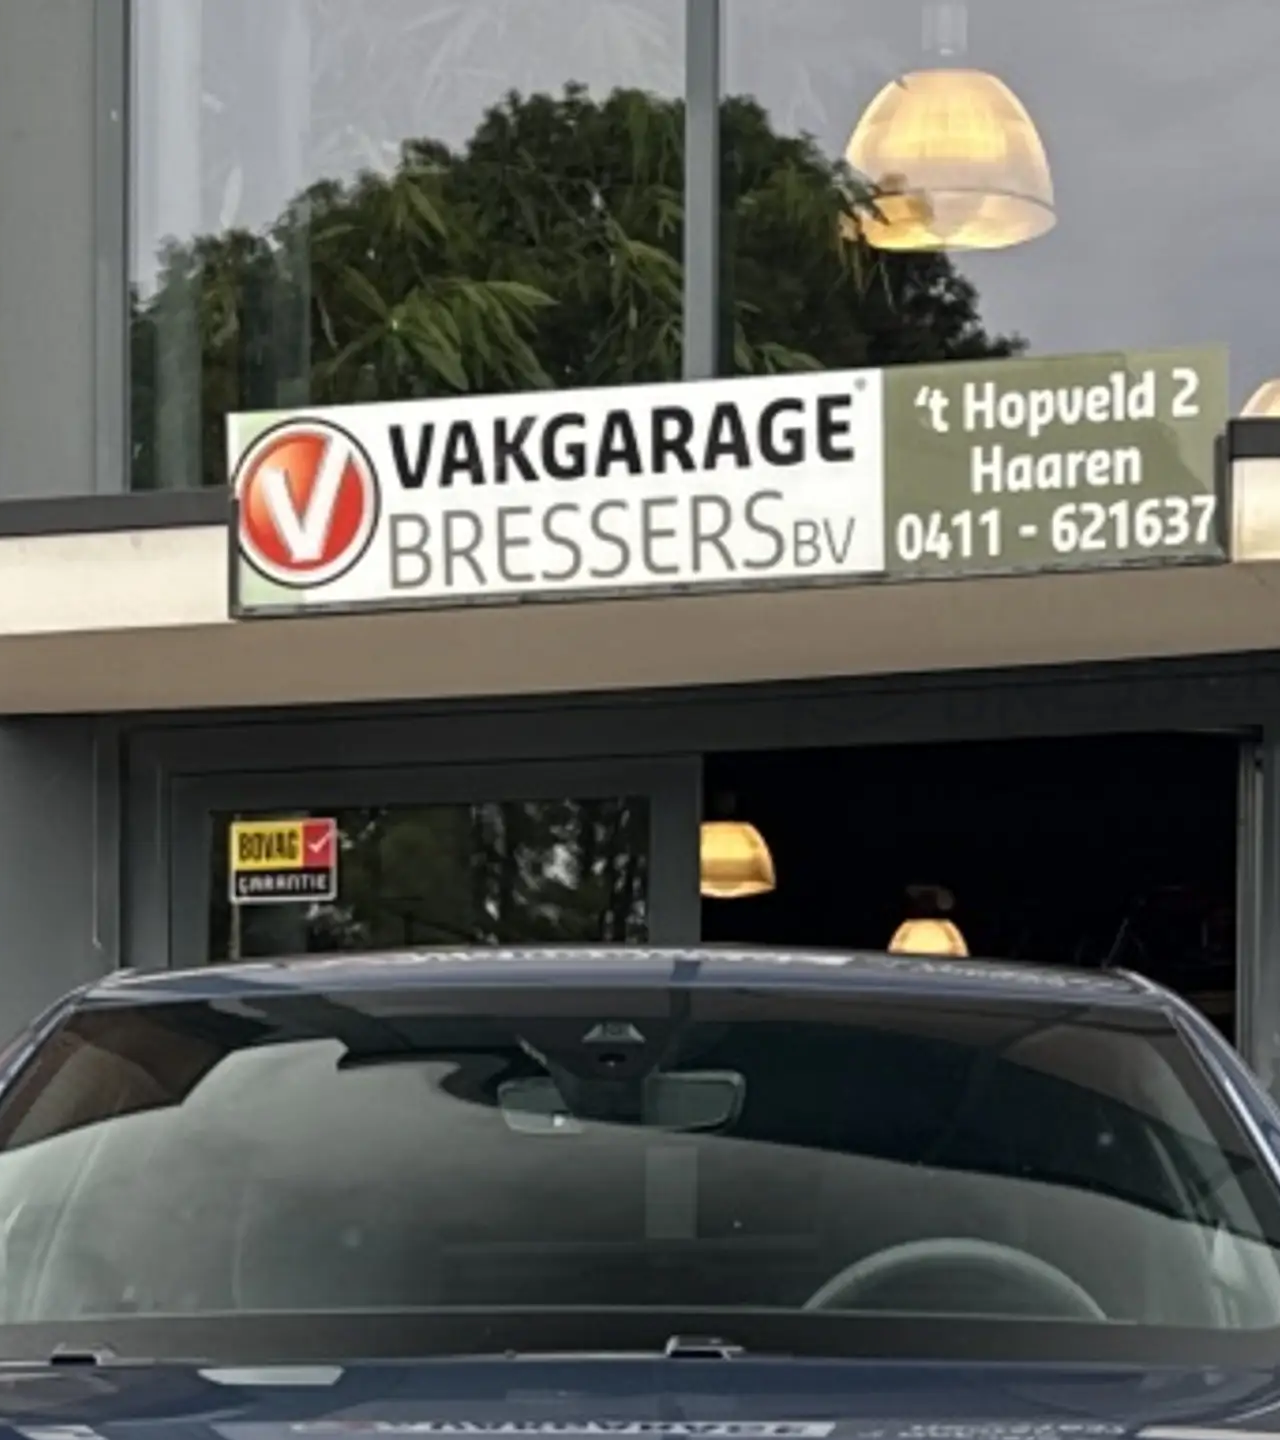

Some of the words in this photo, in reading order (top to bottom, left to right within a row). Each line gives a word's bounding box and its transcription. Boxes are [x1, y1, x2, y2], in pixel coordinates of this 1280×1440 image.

[963, 370, 1156, 437] Hopveld
[1171, 367, 1200, 418] 2
[388, 393, 855, 489] VAKGARAGE
[971, 445, 1142, 494] Haaren
[896, 507, 1001, 562] 0411
[1052, 494, 1217, 553] 621637
[238, 830, 299, 863] BOVAG
[238, 873, 327, 894] GARANTIE
